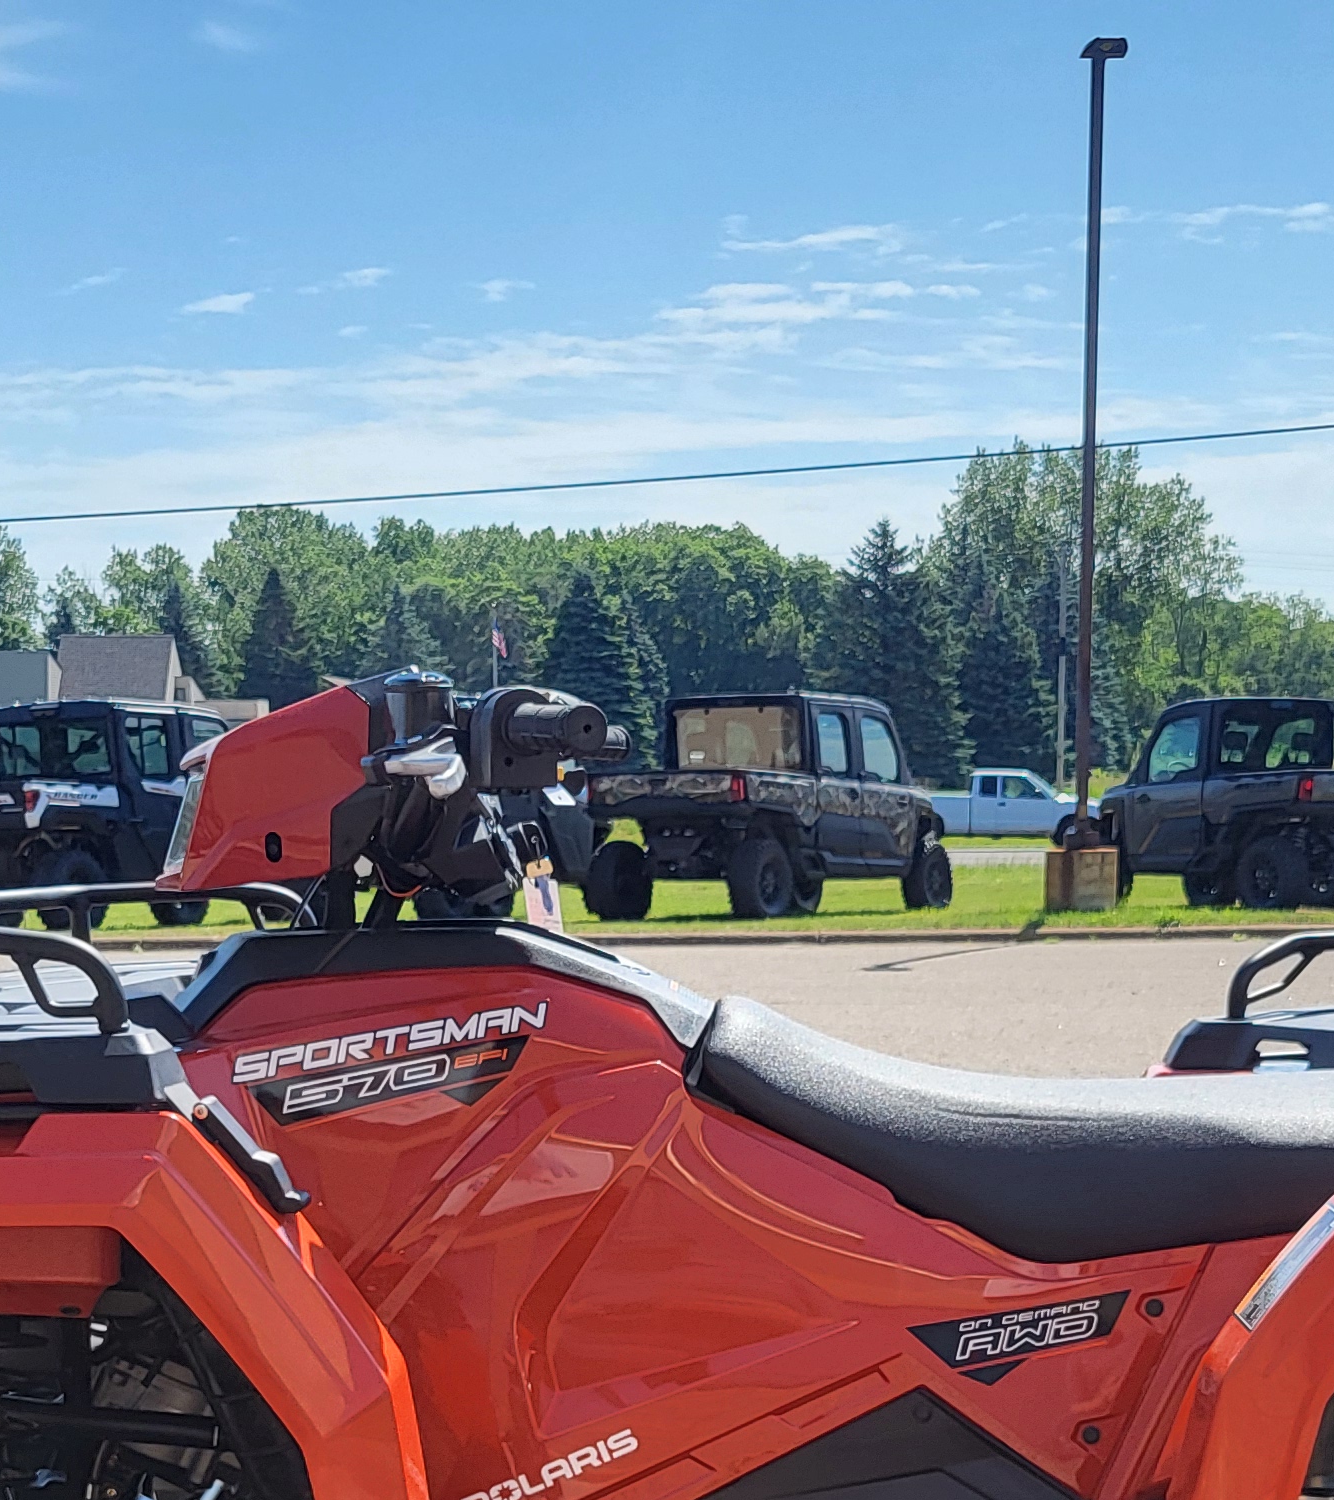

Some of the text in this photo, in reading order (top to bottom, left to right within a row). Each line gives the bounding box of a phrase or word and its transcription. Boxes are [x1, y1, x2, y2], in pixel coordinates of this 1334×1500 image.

[233, 1002, 549, 1083] SPORTSMAN
[283, 1048, 508, 1115] 570 EFI
[955, 1312, 1099, 1361] AWD
[959, 1299, 1100, 1332] ON DEMAND
